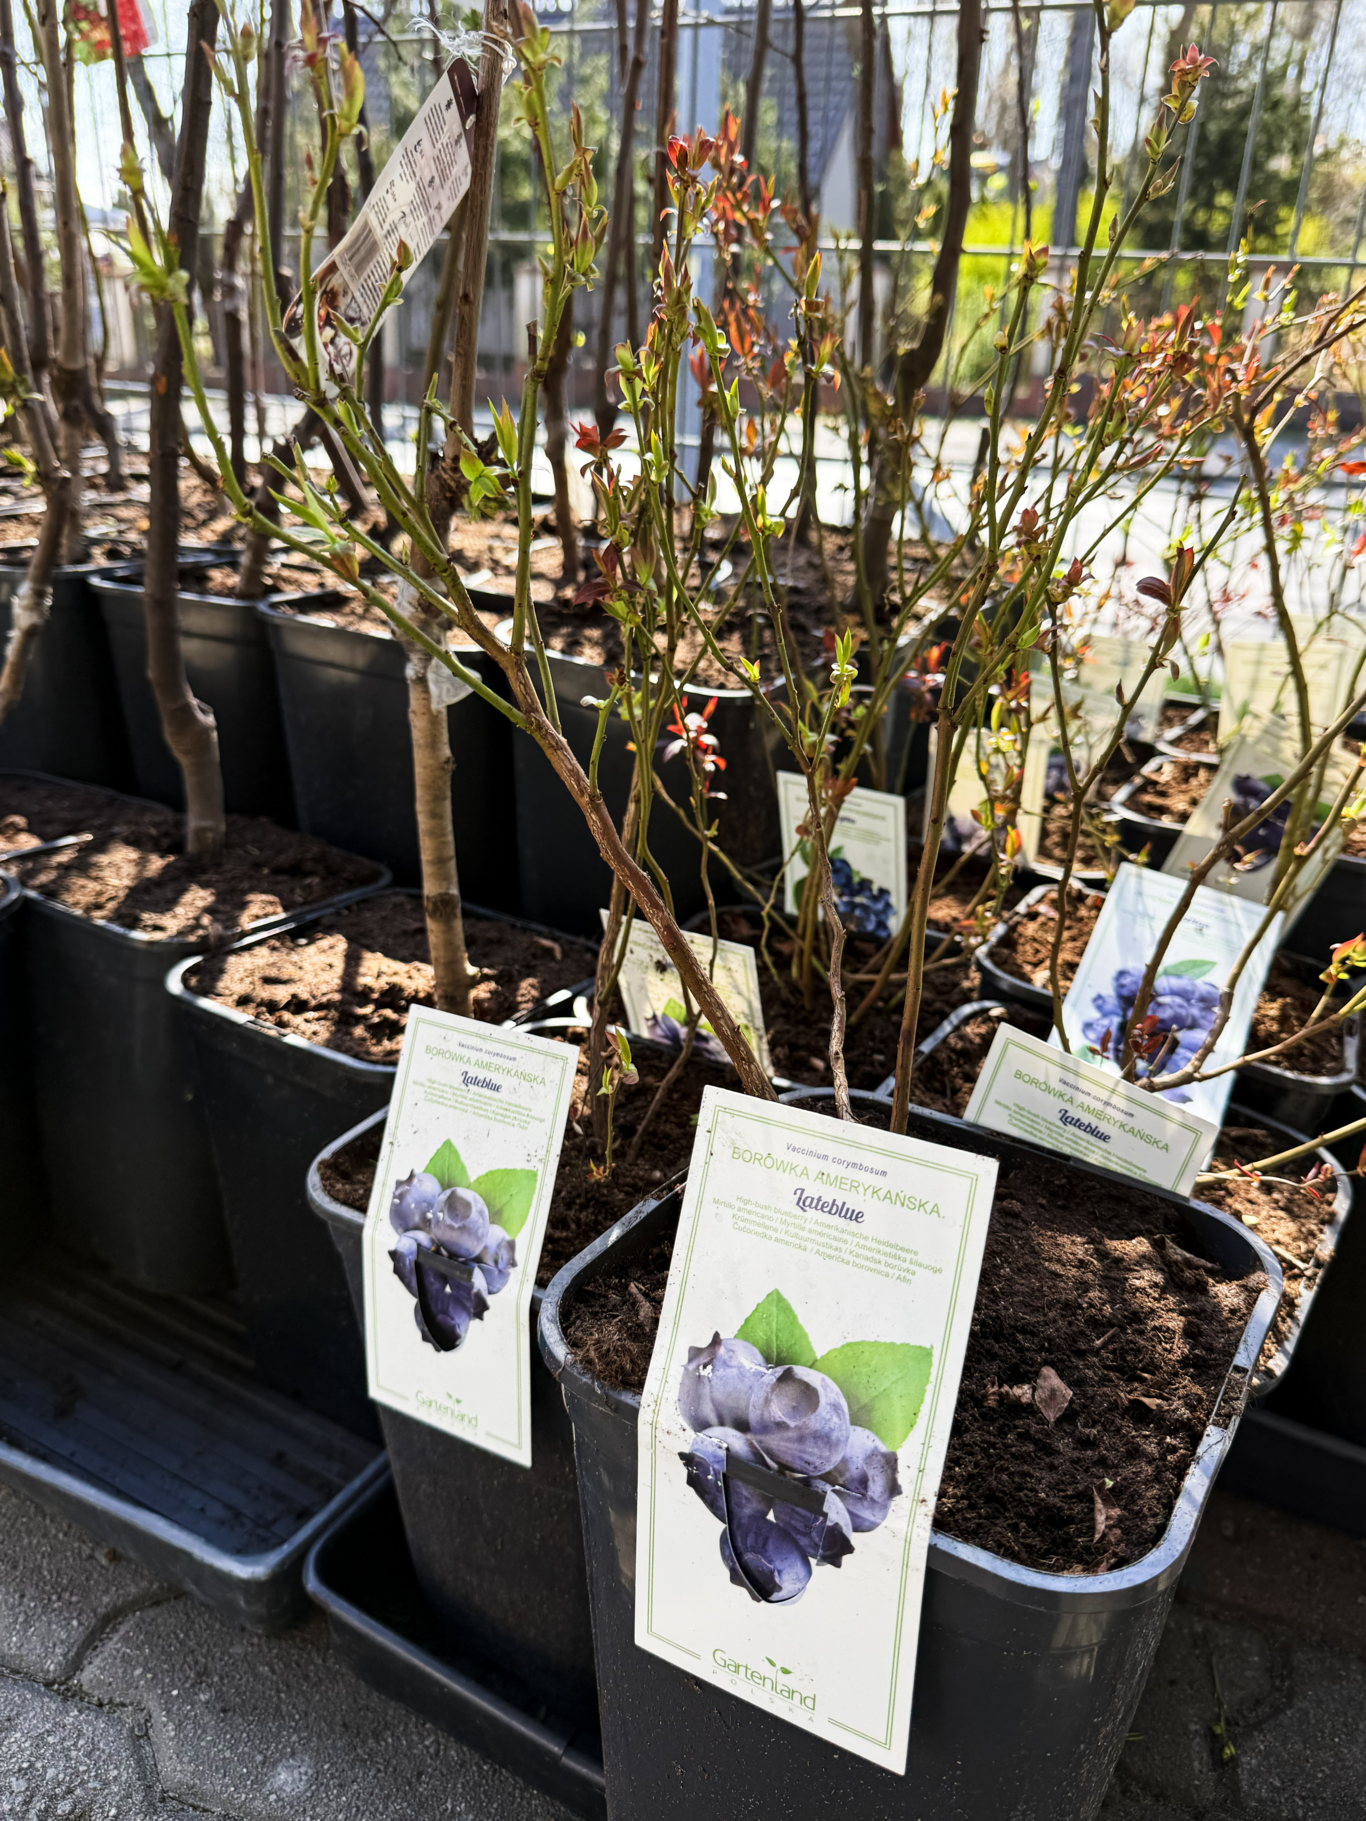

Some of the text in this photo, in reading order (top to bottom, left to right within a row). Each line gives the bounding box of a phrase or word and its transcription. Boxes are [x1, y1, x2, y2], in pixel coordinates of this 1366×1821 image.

[425, 1045, 546, 1086] BORÓWKA AMERYKAŃSKA
[458, 1041, 517, 1061] Vaccinium corymbosum
[461, 1071, 502, 1092] Lateblue
[1058, 1077, 1135, 1118] Vaccinium corymbosum
[1013, 1069, 1074, 1106] BORÓWKA
[1076, 1101, 1170, 1153] AMERYKAŃSKA
[1058, 1108, 1112, 1143] Lateblue
[786, 1142, 888, 1177] Vaccinium corymbosum
[731, 1146, 941, 1218] BORÓWKA AMERYKAŃSKA
[712, 1197, 736, 1210] Mirtillo
[737, 1206, 774, 1222] americano
[780, 1217, 806, 1232] Myrtille
[807, 1227, 849, 1245] américaine
[736, 1195, 773, 1212] High-bush
[773, 1207, 808, 1224] blueberry
[813, 1219, 869, 1241] Amerikanische
[871, 1235, 919, 1256] Heidelbeere
[793, 1187, 865, 1224] Lateblue
[774, 1236, 807, 1252] americká
[852, 1260, 890, 1278] borovnica
[784, 1228, 842, 1253] Kultuurmustikas
[849, 1248, 882, 1265] Kanadsk
[712, 1648, 816, 1711] Gartenland
